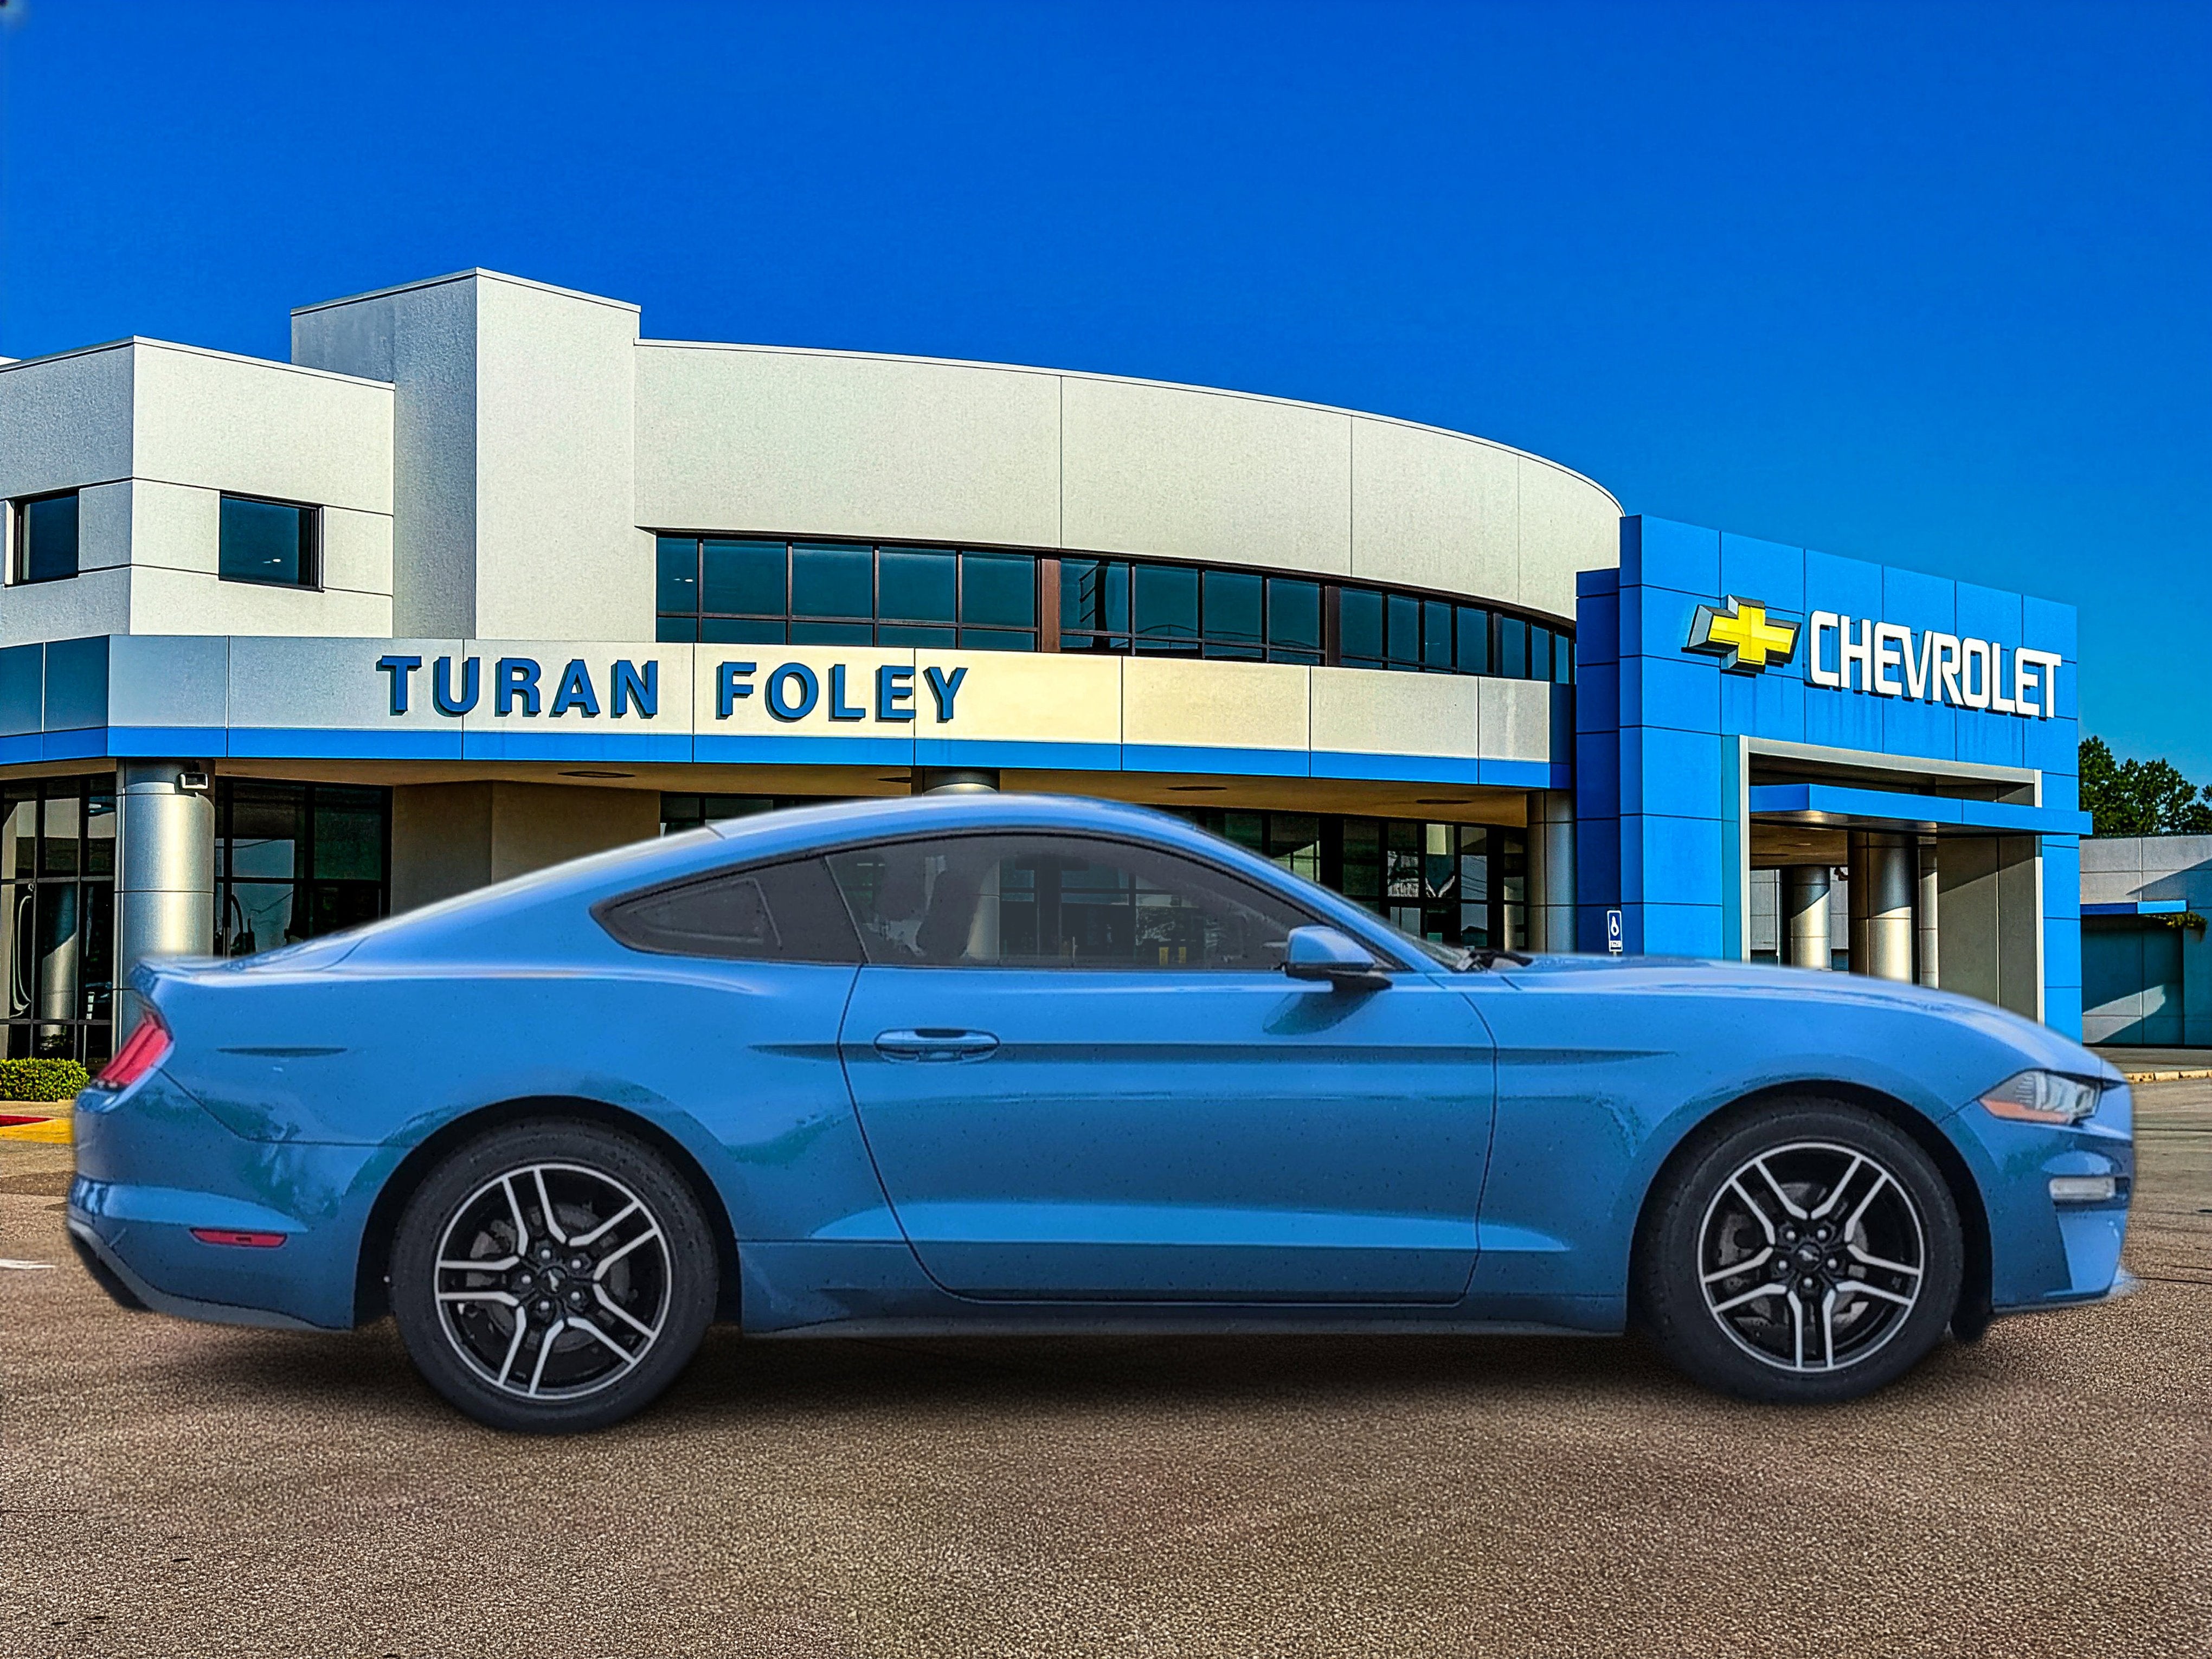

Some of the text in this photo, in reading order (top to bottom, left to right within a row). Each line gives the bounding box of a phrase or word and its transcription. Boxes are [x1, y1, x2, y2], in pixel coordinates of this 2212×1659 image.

[377, 655, 969, 722] TURAN FOLEY
[1809, 609, 2062, 719] CHEVROLET
